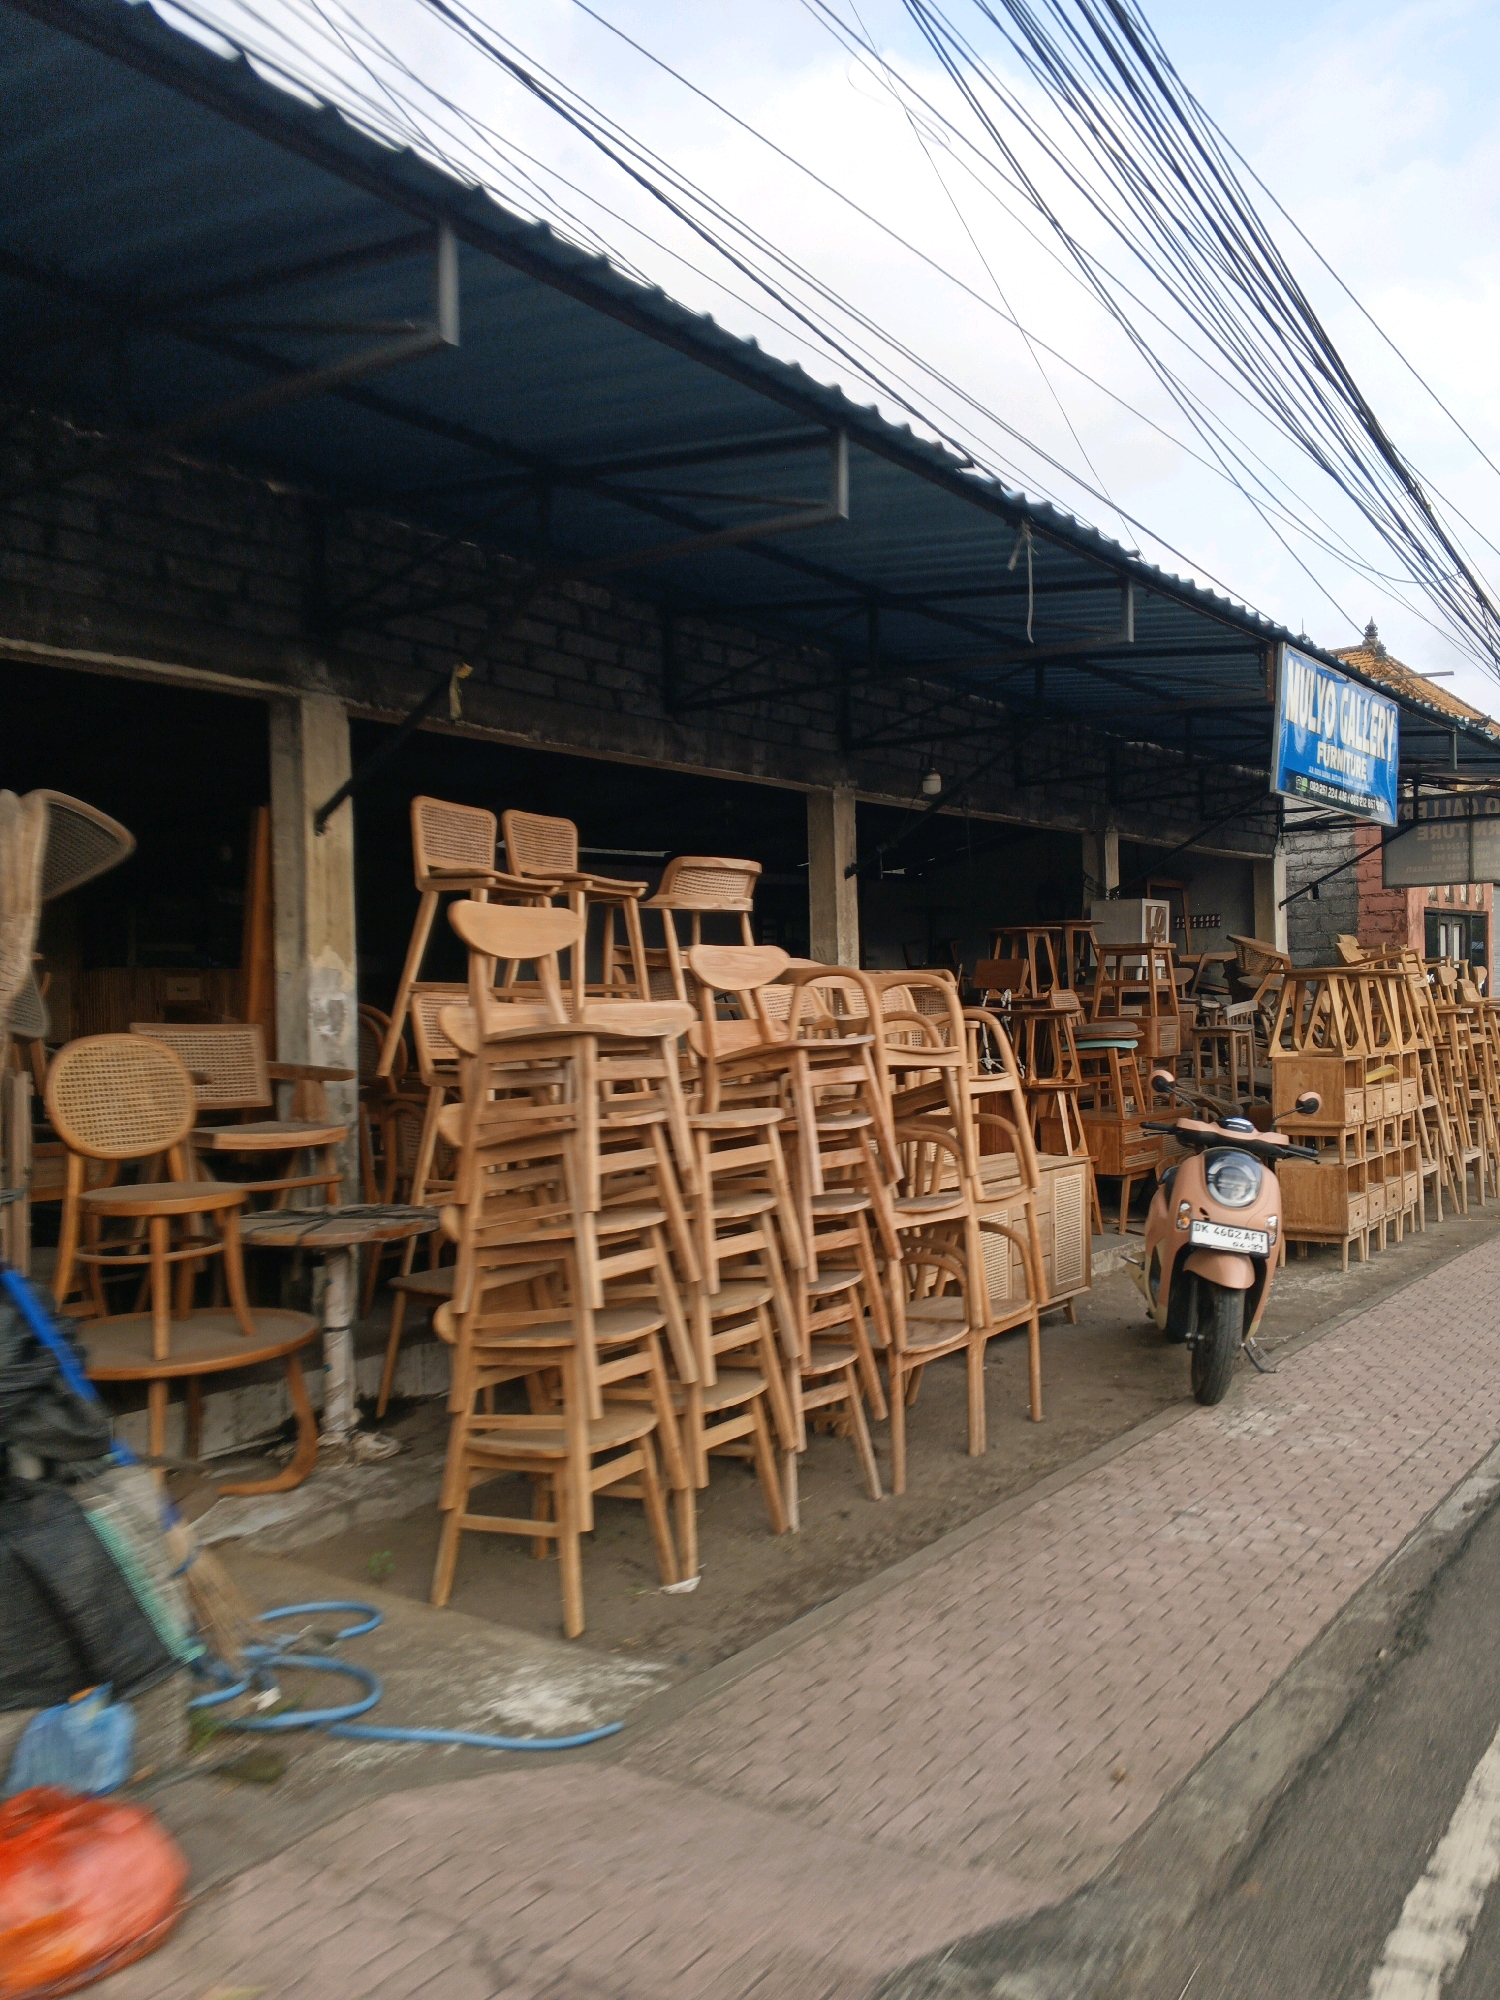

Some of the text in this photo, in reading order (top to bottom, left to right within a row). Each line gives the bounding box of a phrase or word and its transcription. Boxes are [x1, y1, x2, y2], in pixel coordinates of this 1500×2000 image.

[1286, 658, 1396, 762] MULYO GALLERY
[1317, 741, 1367, 780] FURNITURE
[1194, 1223, 1209, 1234] DK
[1213, 1226, 1242, 1240] 4602
